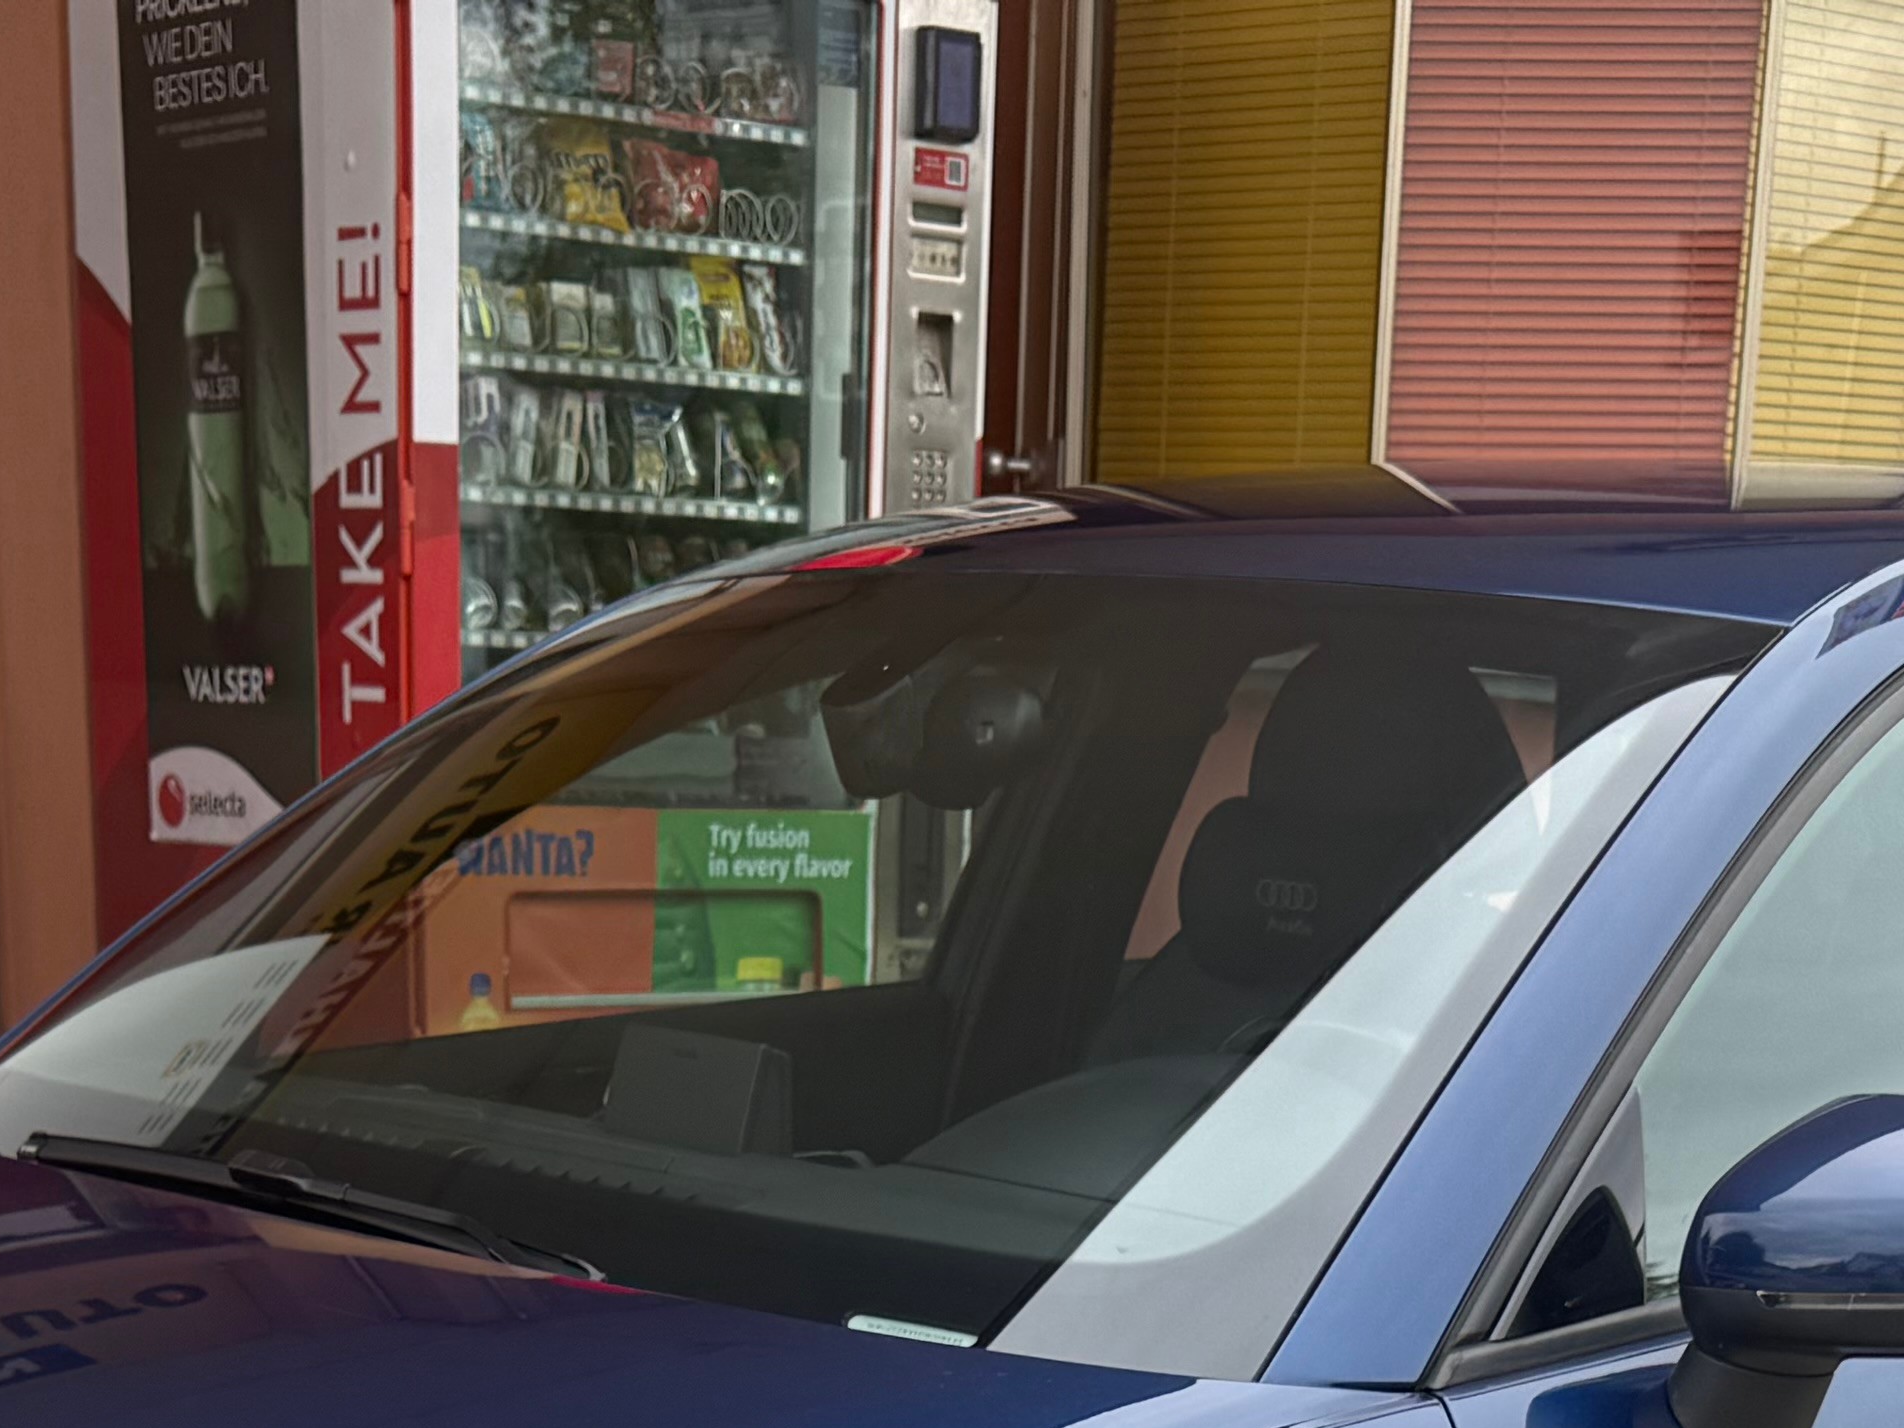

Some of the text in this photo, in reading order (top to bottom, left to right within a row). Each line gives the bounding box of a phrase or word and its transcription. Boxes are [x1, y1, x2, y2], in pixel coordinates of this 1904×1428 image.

[142, 18, 233, 68] WIE DEIN
[152, 65, 227, 112] BESTES
[336, 222, 386, 725] TAKE ME!
[182, 664, 267, 704] VALSER
[189, 790, 247, 819] selecta
[707, 821, 811, 854] Try fusion
[707, 851, 853, 884] in every flavor
